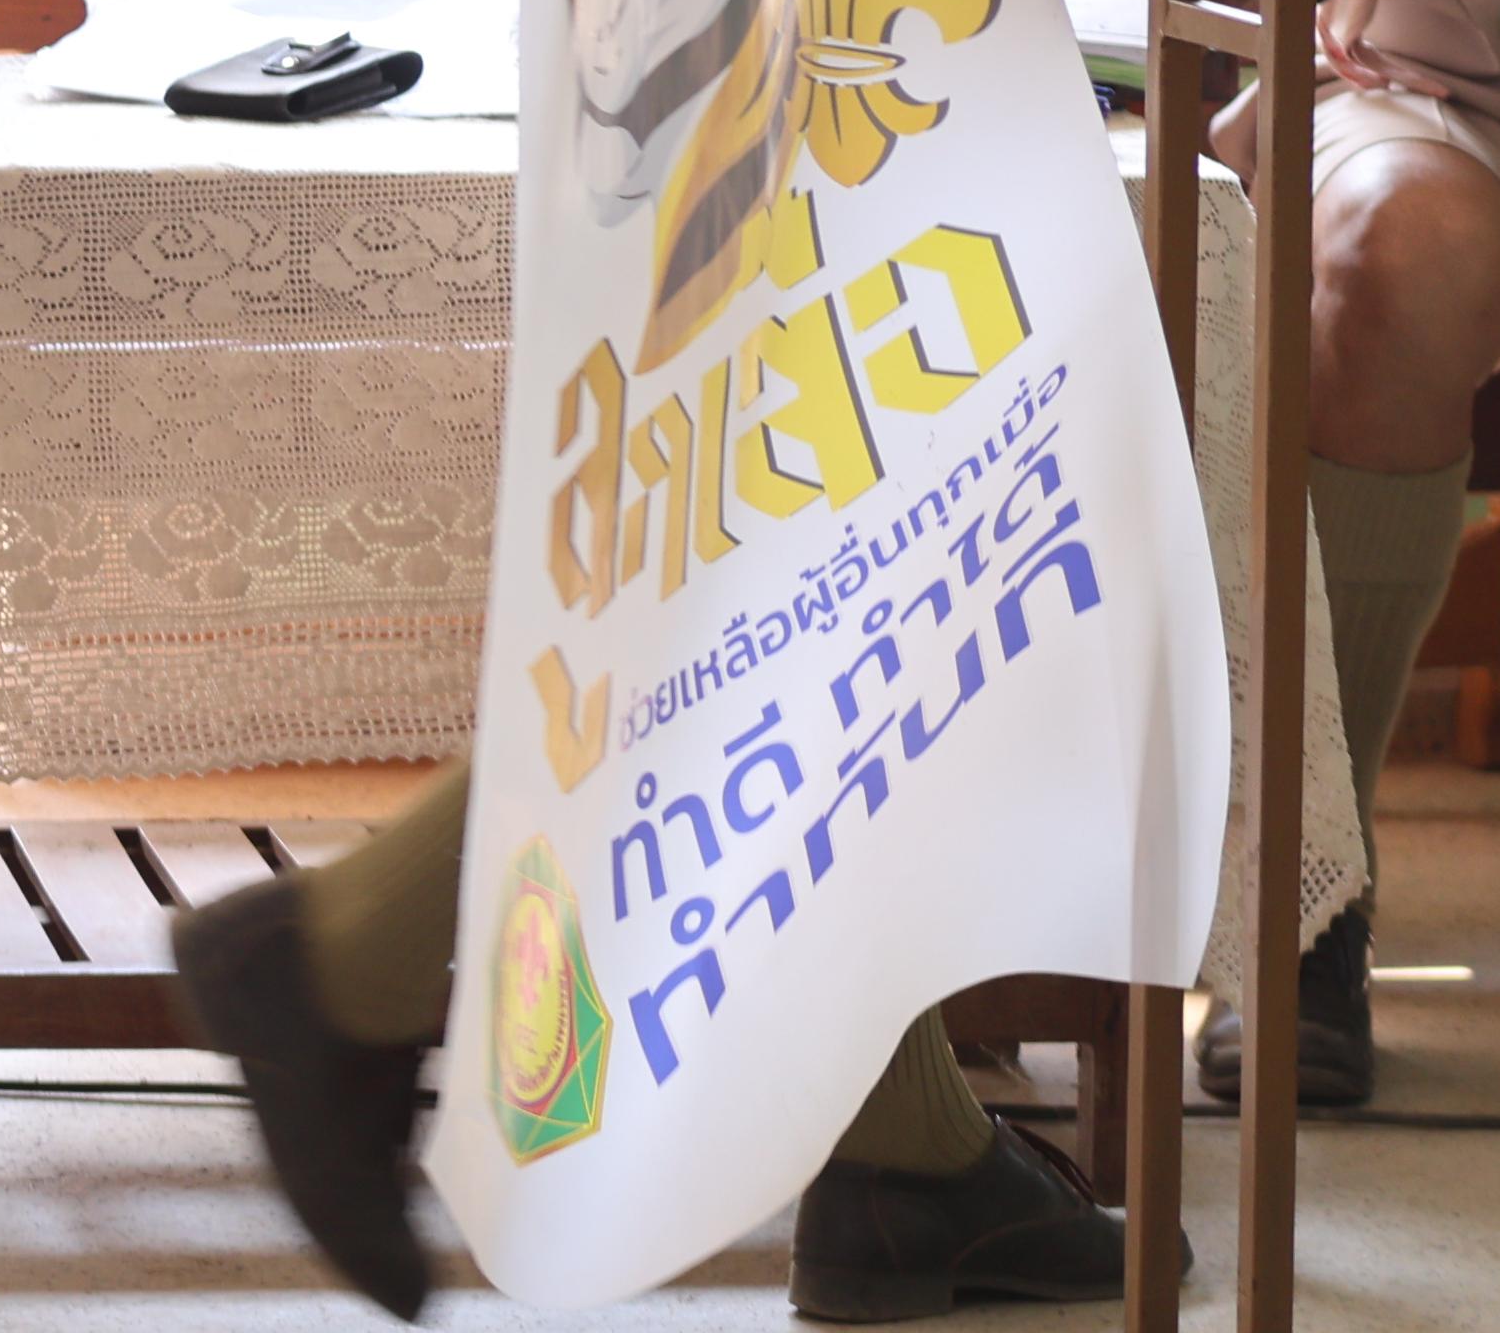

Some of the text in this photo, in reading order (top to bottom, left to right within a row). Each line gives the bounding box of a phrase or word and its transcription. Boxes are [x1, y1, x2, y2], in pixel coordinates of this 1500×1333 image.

[528, 188, 1033, 794] ลูกเสือ
[610, 421, 1064, 923] ทำดี ทำได้
[628, 497, 1102, 1089] ทำทันที
